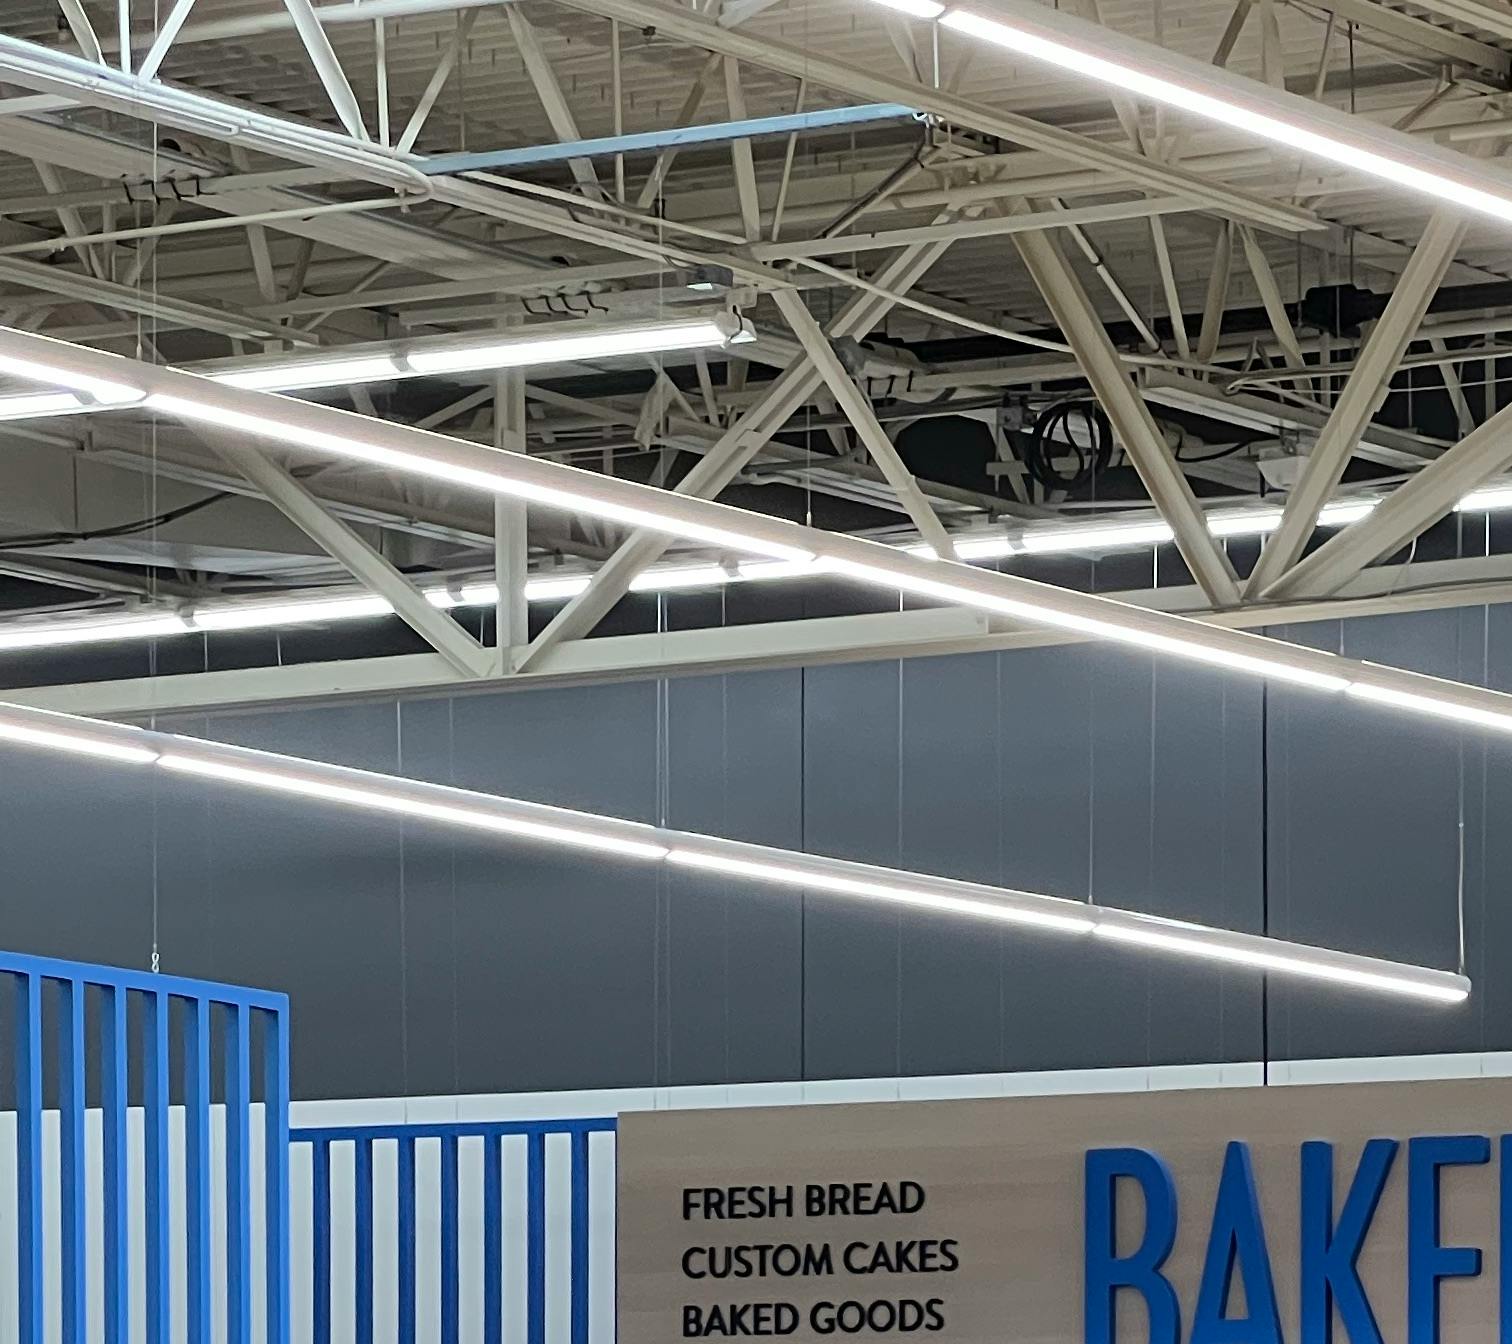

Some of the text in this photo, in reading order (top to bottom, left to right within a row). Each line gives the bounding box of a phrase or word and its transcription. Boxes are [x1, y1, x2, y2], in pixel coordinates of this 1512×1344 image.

[682, 1180, 926, 1221] FRESH BREAD
[681, 1238, 959, 1279] CUSTOM CAKES
[682, 1298, 945, 1338] BAKED GOODS
